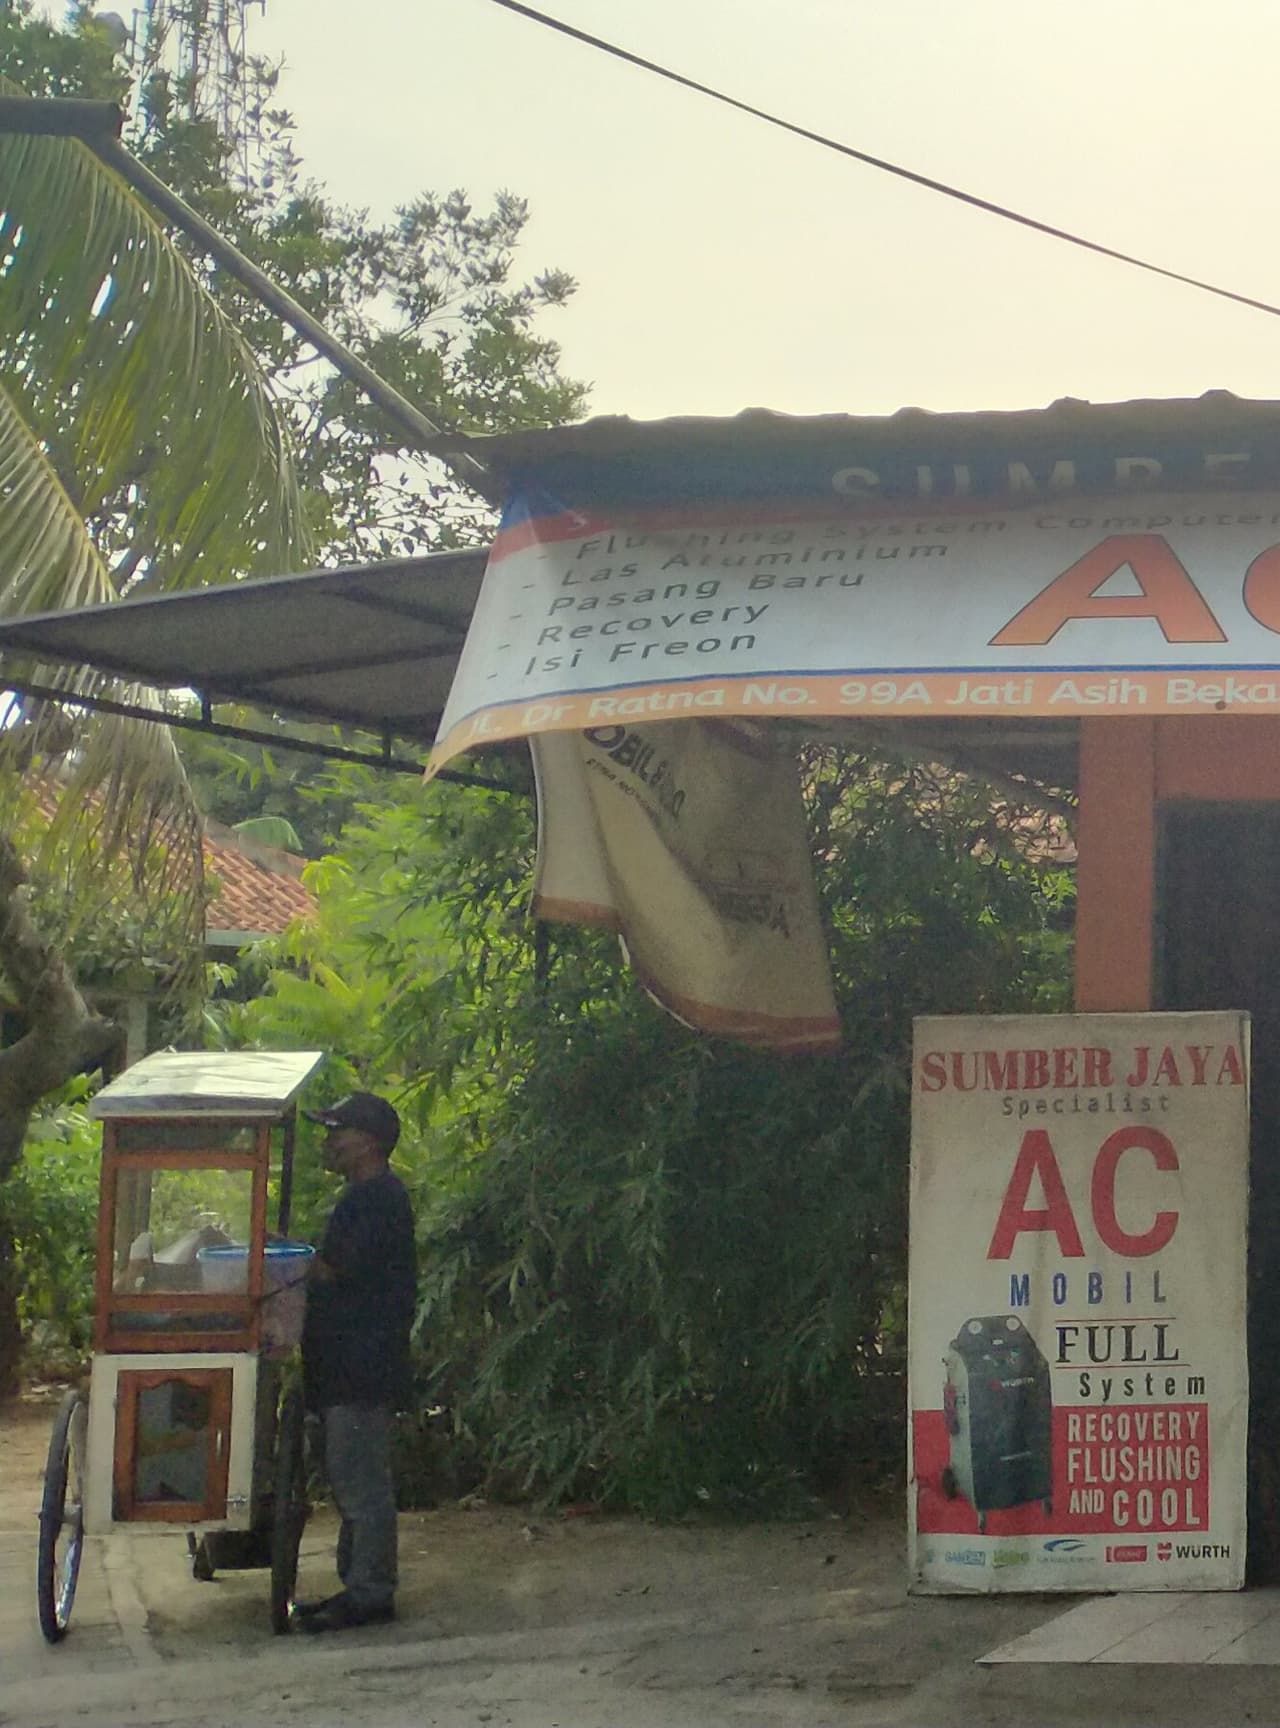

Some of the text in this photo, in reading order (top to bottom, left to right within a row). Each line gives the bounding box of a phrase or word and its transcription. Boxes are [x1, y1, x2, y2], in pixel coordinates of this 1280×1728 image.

[561, 562, 638, 587] Las
[548, 572, 865, 618] Pasang Baru
[537, 602, 769, 646] Recovery
[525, 632, 757, 676] Isi Freon
[521, 702, 575, 729] Dr
[588, 687, 725, 720] Ratna
[742, 683, 817, 706] No.
[840, 680, 932, 704] 99A
[946, 678, 1034, 705] Jati
[1048, 678, 1146, 704] Asih
[920, 1044, 1246, 1092] SUMBER JAYA
[1002, 1093, 1169, 1119] Specialist
[987, 1125, 1180, 1260] AC
[1010, 1271, 1167, 1306] MOBIL
[1055, 1323, 1179, 1363] FULL
[1079, 1371, 1205, 1402] System
[1068, 1411, 1200, 1442] RECOVERY
[1068, 1446, 1201, 1484] FLUSHING
[1069, 1488, 1200, 1527] AND COOL
